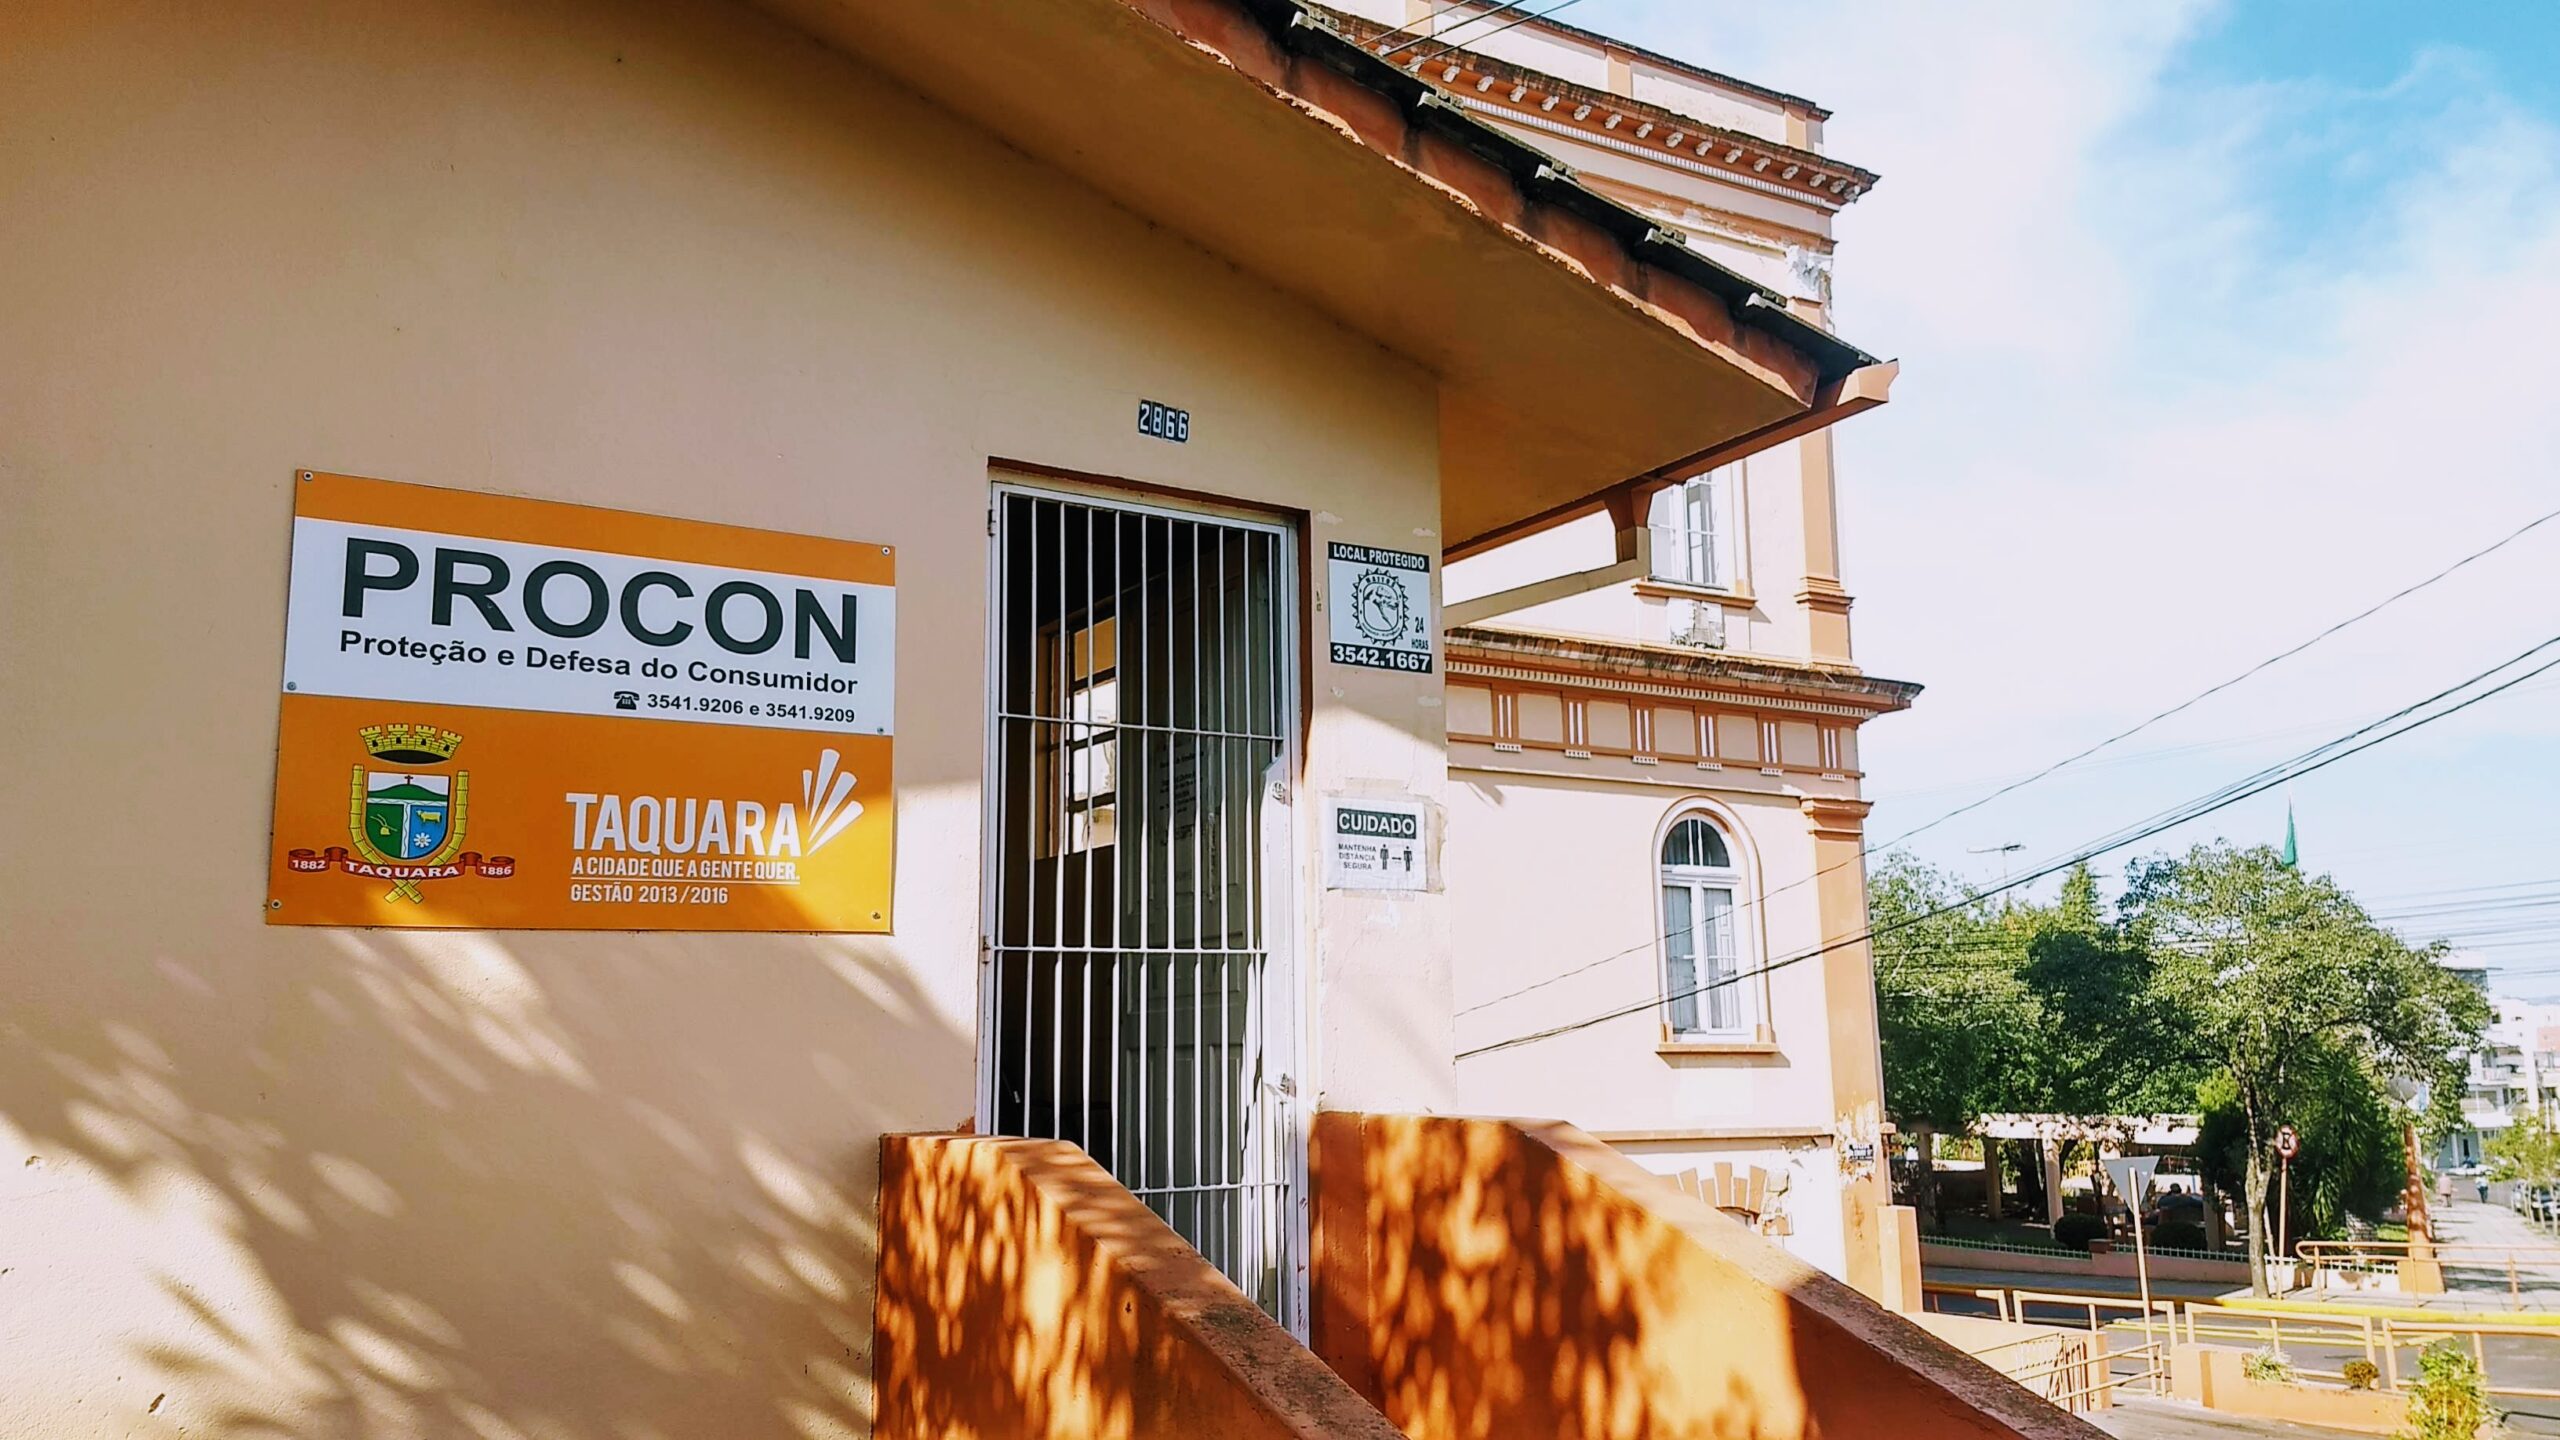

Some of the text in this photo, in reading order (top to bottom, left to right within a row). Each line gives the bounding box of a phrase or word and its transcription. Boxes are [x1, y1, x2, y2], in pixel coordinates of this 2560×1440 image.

[1140, 403, 1187, 439] 2866
[1333, 544, 1425, 569] LOCAL PROTEGIDO
[341, 537, 858, 664] PROCON
[1415, 617, 1424, 634] 24
[340, 630, 858, 694] Proteção e Defesa do Consumidor
[1333, 645, 1430, 671] 3542.1667
[647, 694, 855, 722] 3541.9206 e 3541.9209
[566, 793, 801, 856] TAQUARA
[1339, 813, 1415, 835] CUIDADO
[1338, 843, 1377, 852] MANTENHA
[291, 860, 326, 869] 1882
[345, 860, 459, 878] TAQUARA
[480, 866, 512, 876] 1886
[572, 857, 800, 880] A CIDADE QUE A GENTE QUER.
[1343, 861, 1372, 870] SEGURA
[571, 882, 633, 902] GESTÃO
